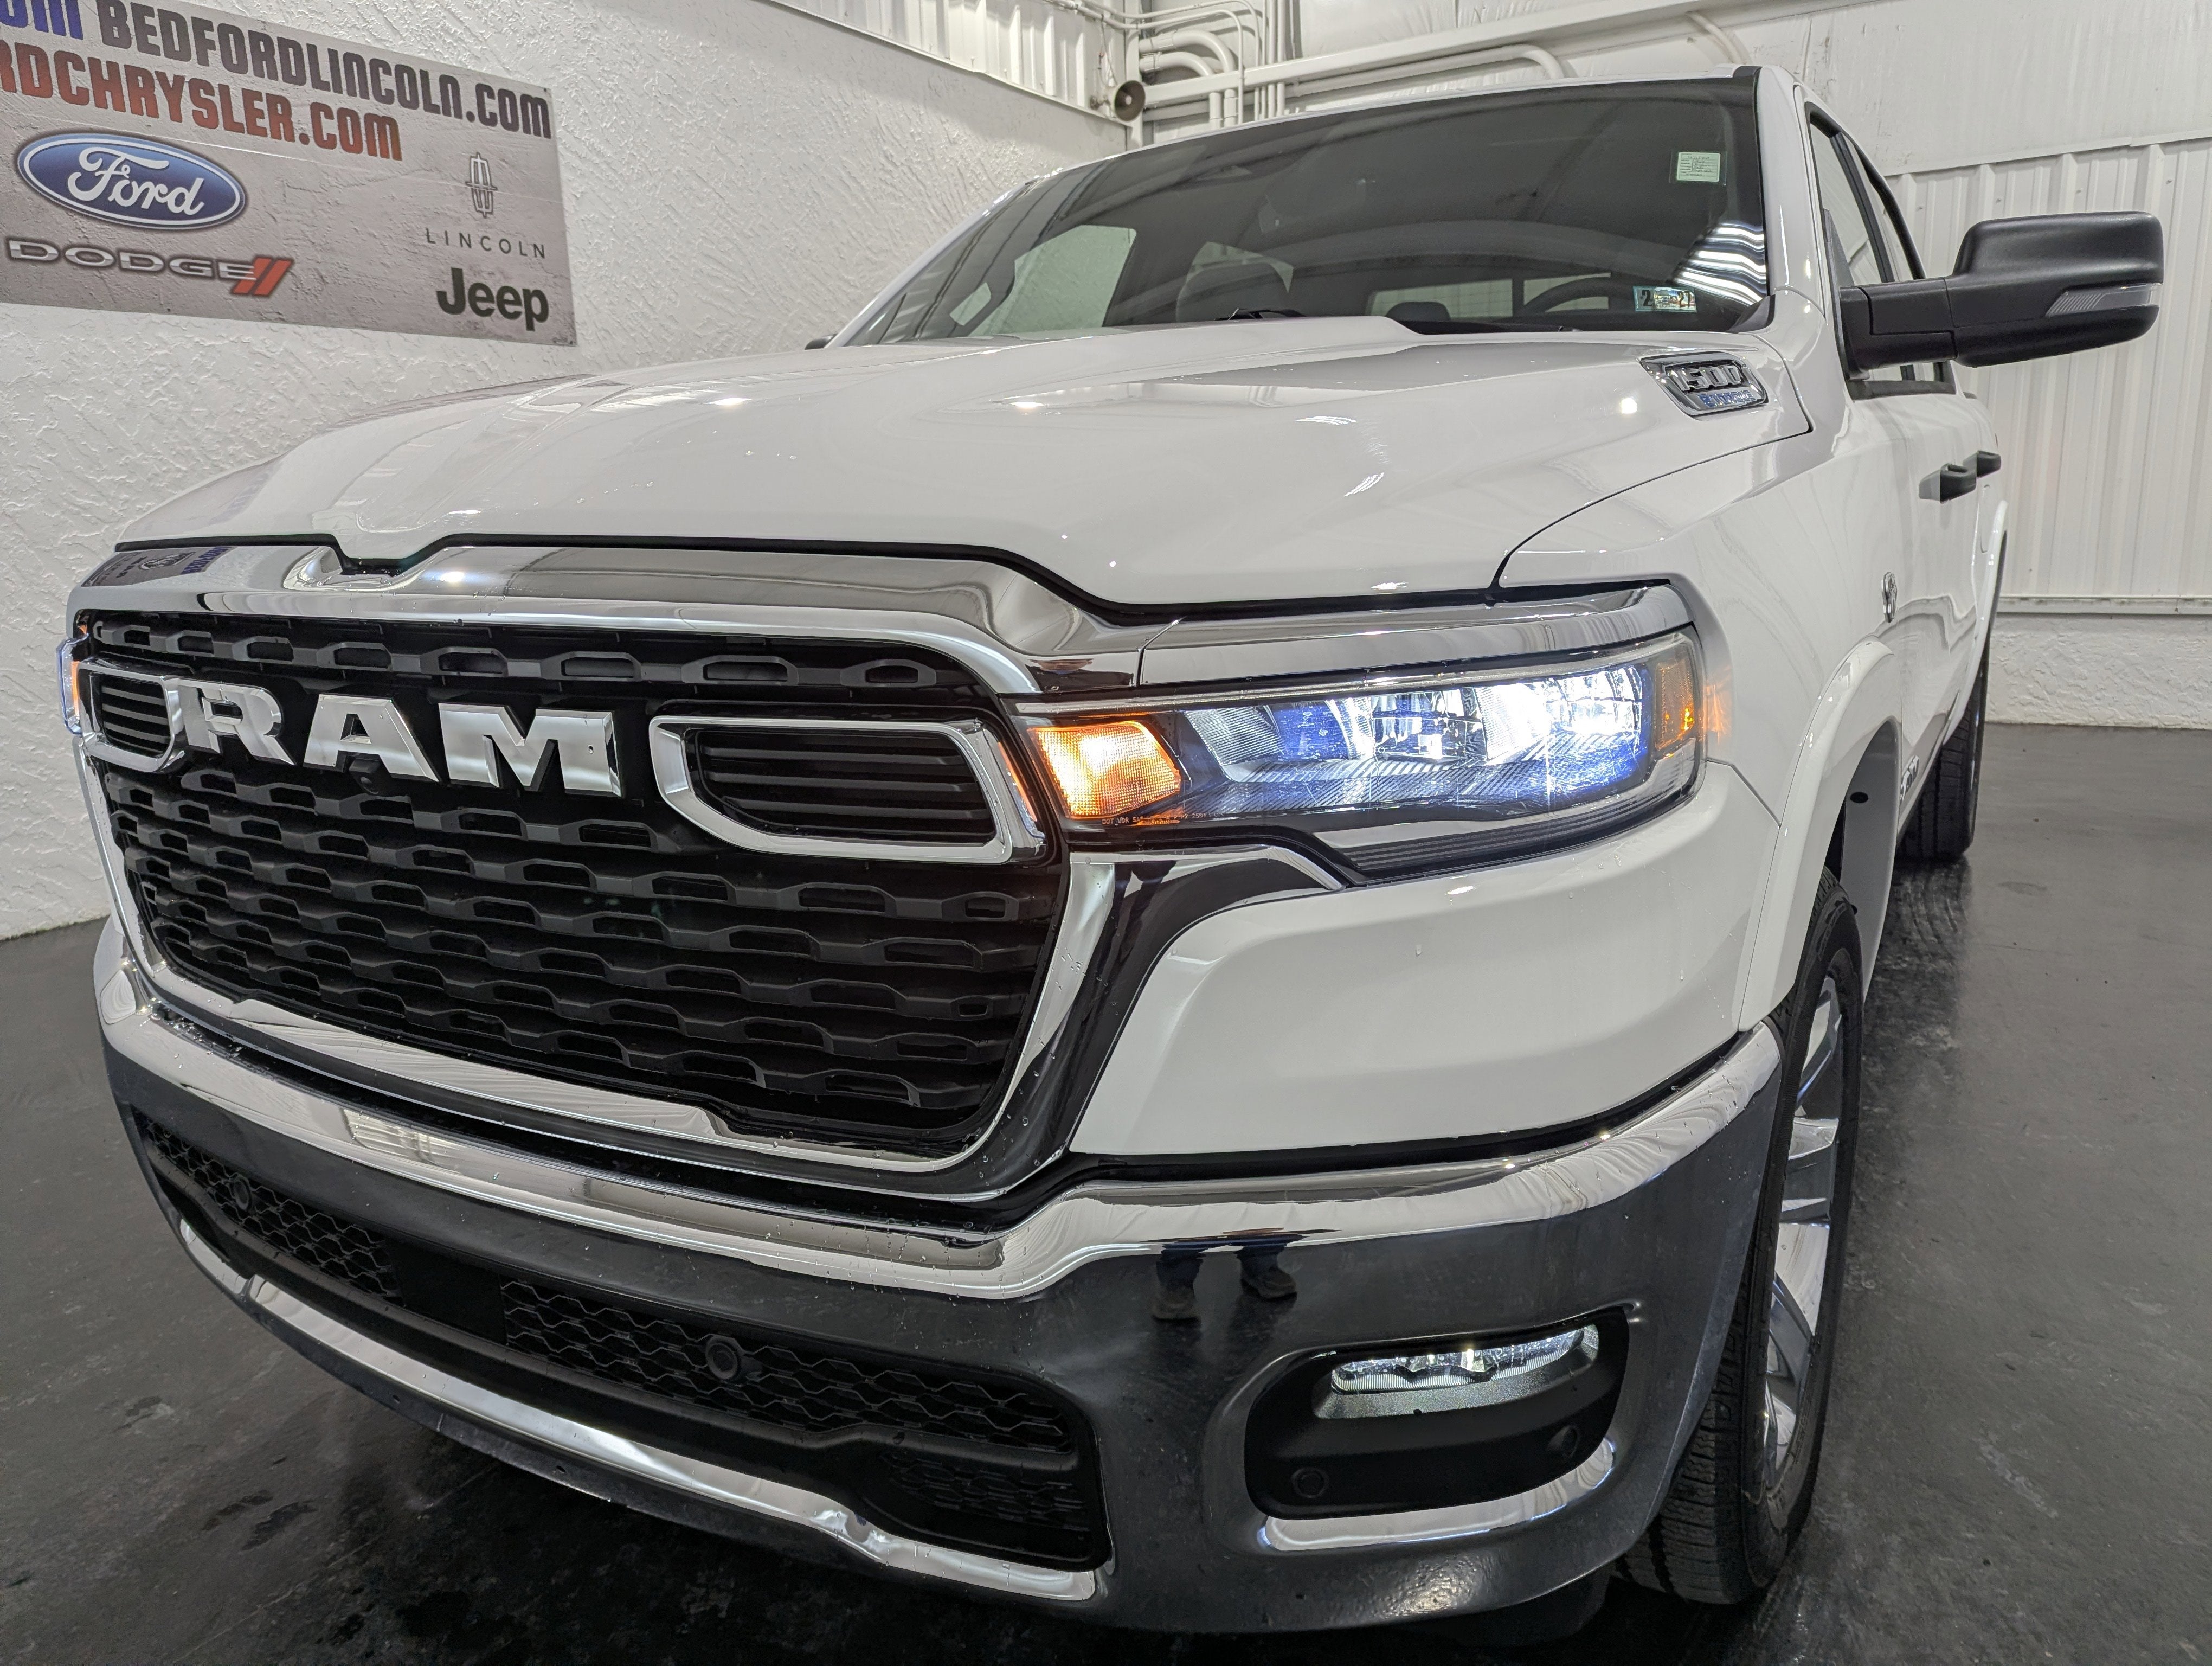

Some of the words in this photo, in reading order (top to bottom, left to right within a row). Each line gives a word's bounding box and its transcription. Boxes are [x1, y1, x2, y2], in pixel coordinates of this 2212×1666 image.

[67, 147, 205, 215] Ford
[9, 240, 257, 281] DODGE
[426, 228, 545, 259] LINCOLN
[436, 267, 549, 332] Jeep
[178, 677, 622, 797] RAM
